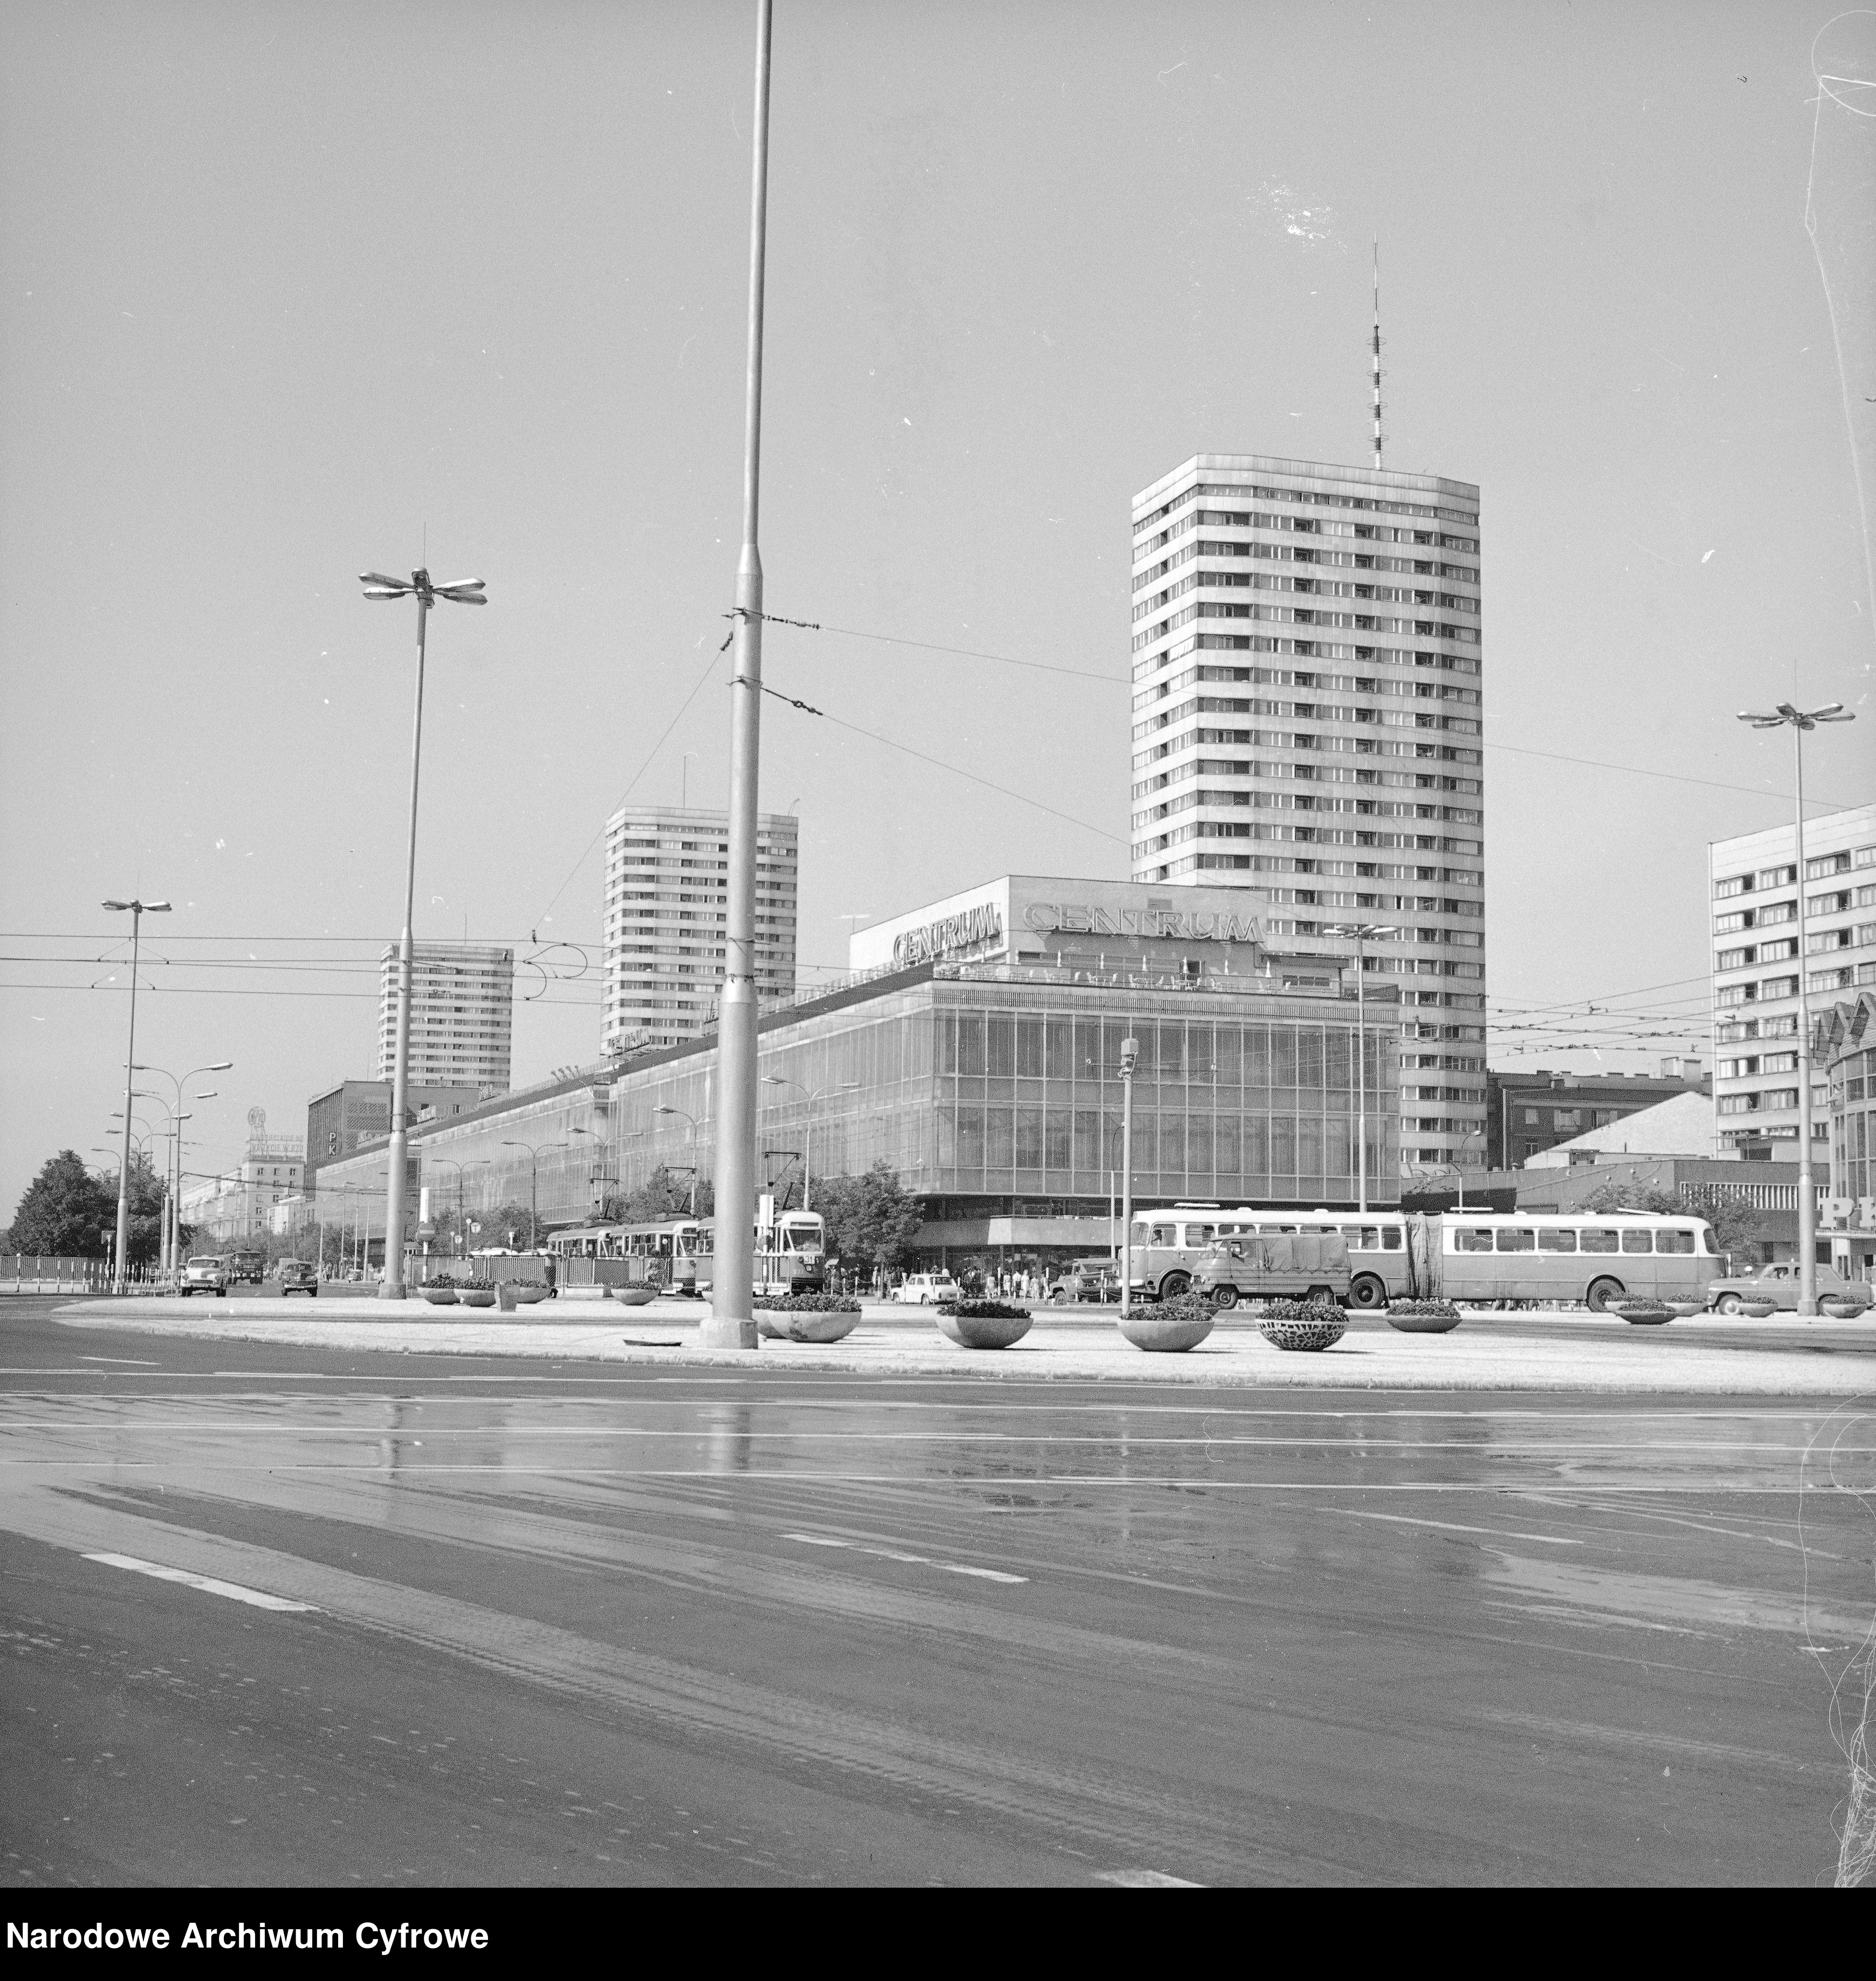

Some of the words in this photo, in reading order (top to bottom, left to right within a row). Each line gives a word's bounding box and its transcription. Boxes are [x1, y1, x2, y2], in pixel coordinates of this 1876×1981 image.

[893, 902, 997, 963] CENTRUM
[1023, 902, 1265, 942] CENTRUM
[805, 1255, 813, 1263] 31
